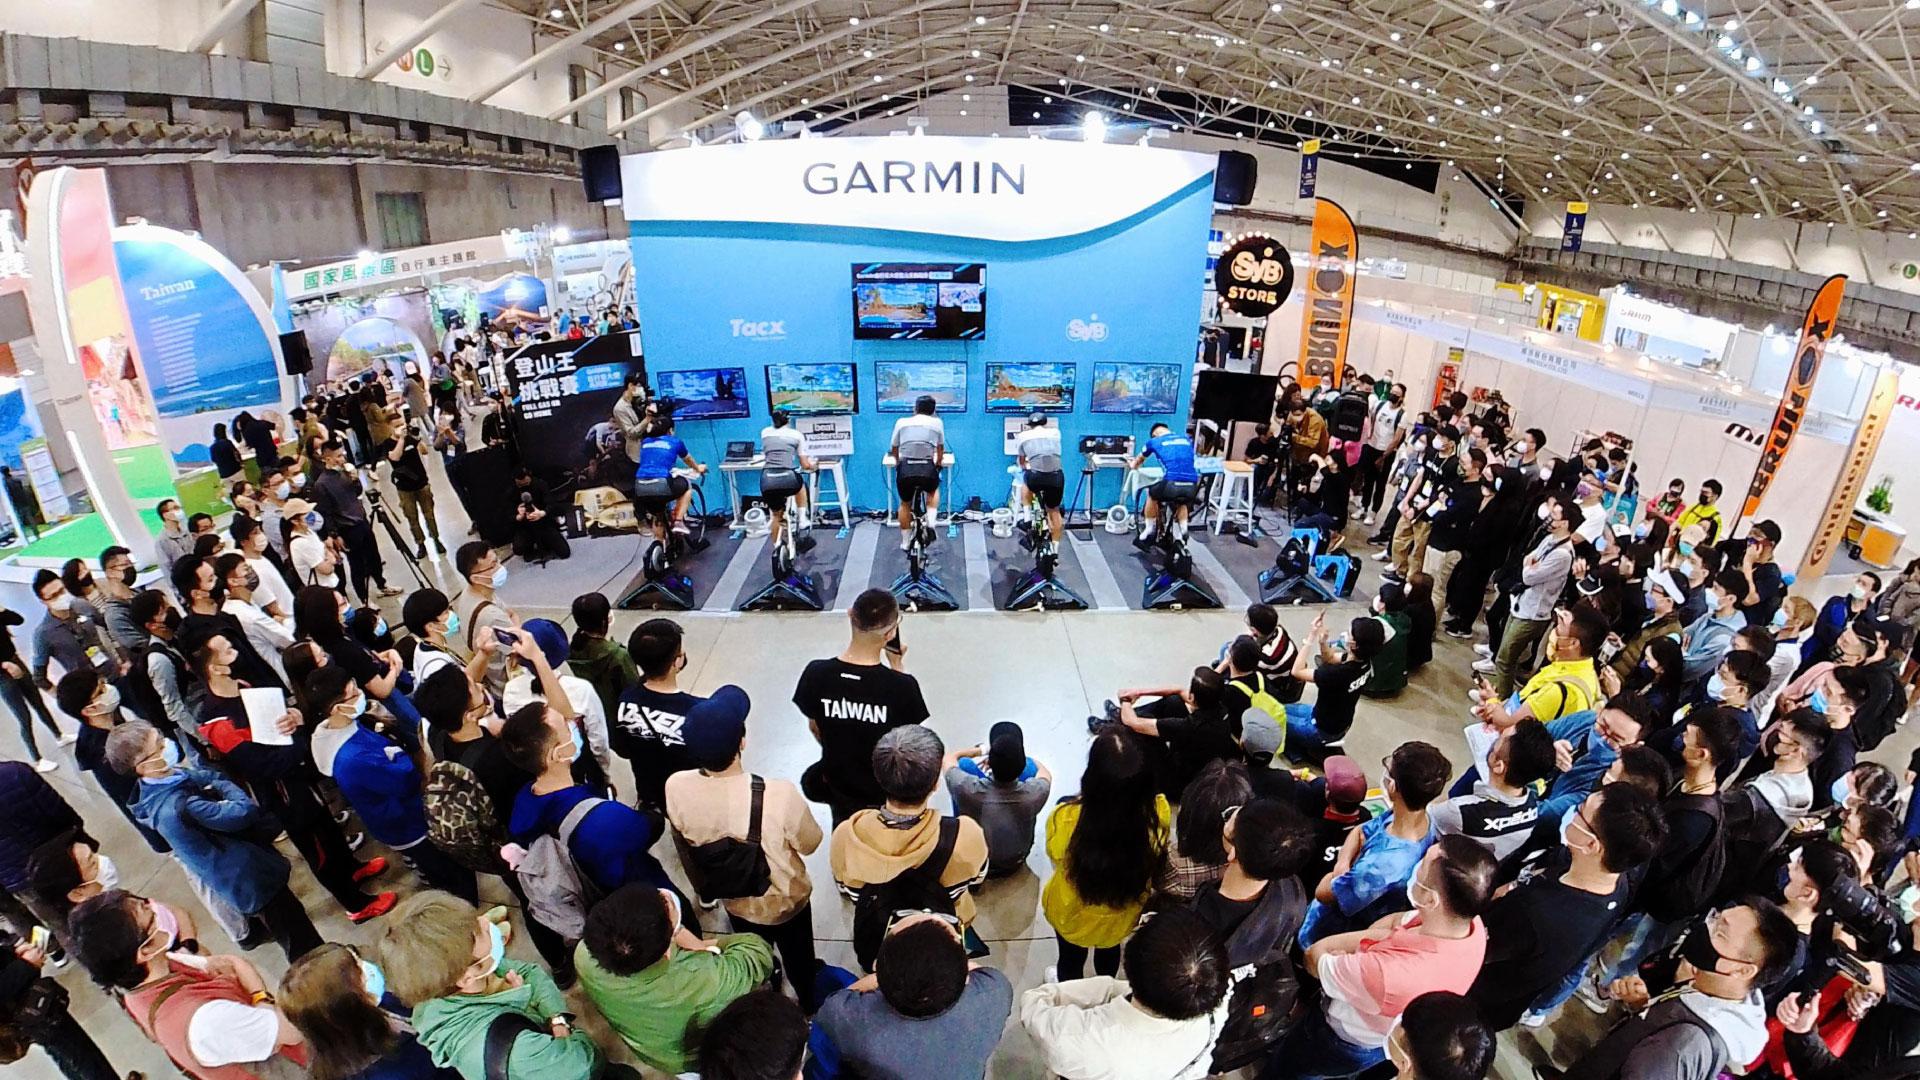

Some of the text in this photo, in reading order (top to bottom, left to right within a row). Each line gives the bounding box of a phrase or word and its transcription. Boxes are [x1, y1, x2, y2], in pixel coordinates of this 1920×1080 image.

[420, 51, 431, 73] L
[803, 160, 1025, 195] GARMIN
[141, 280, 197, 300] Taiwan
[1228, 286, 1277, 305] STORE
[730, 318, 786, 337] Tacx
[514, 351, 577, 378] 登山王
[519, 375, 580, 402] 挑戰賽
[814, 423, 834, 432] beat
[820, 697, 887, 724] TAIWAN
